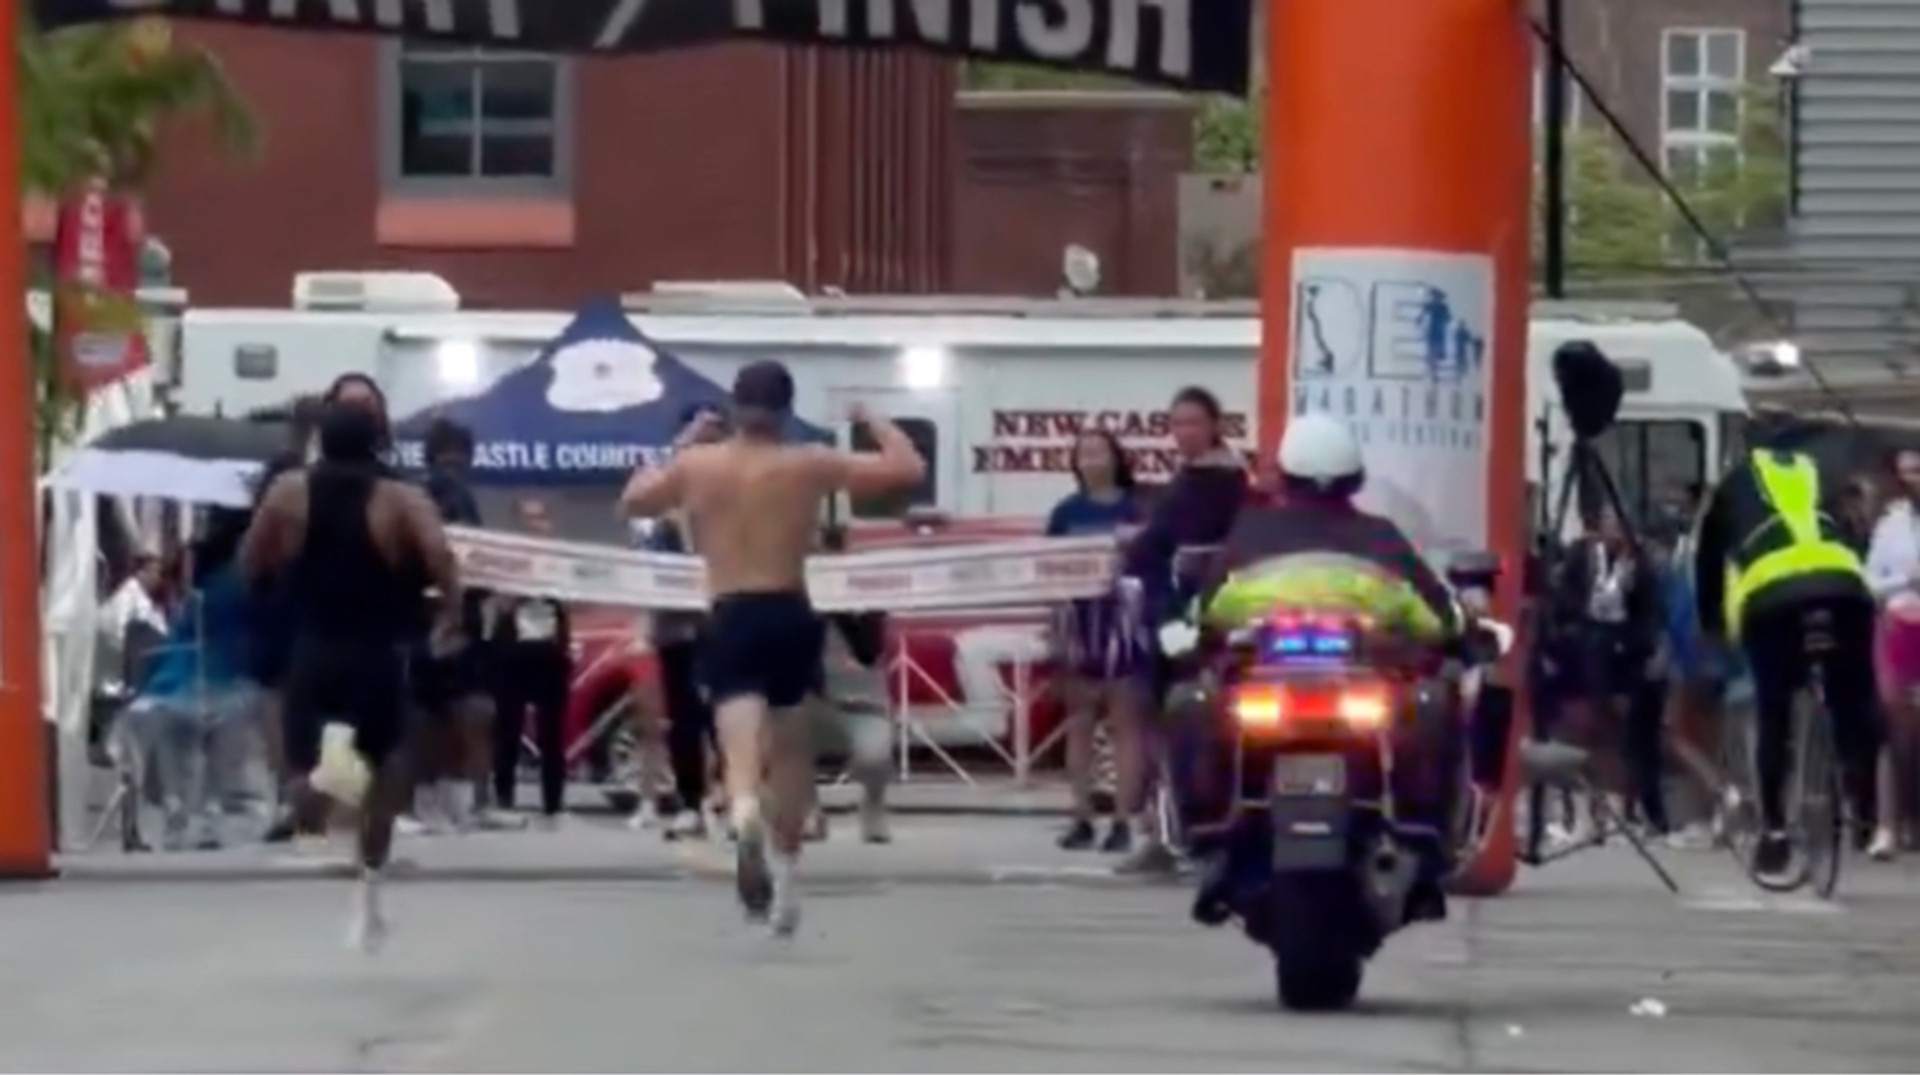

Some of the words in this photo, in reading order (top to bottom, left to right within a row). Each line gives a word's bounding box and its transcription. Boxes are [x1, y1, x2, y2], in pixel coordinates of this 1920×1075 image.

[993, 410, 1083, 437] NEW
[1096, 411, 1247, 438] CASE
[471, 442, 549, 470] ASTLE
